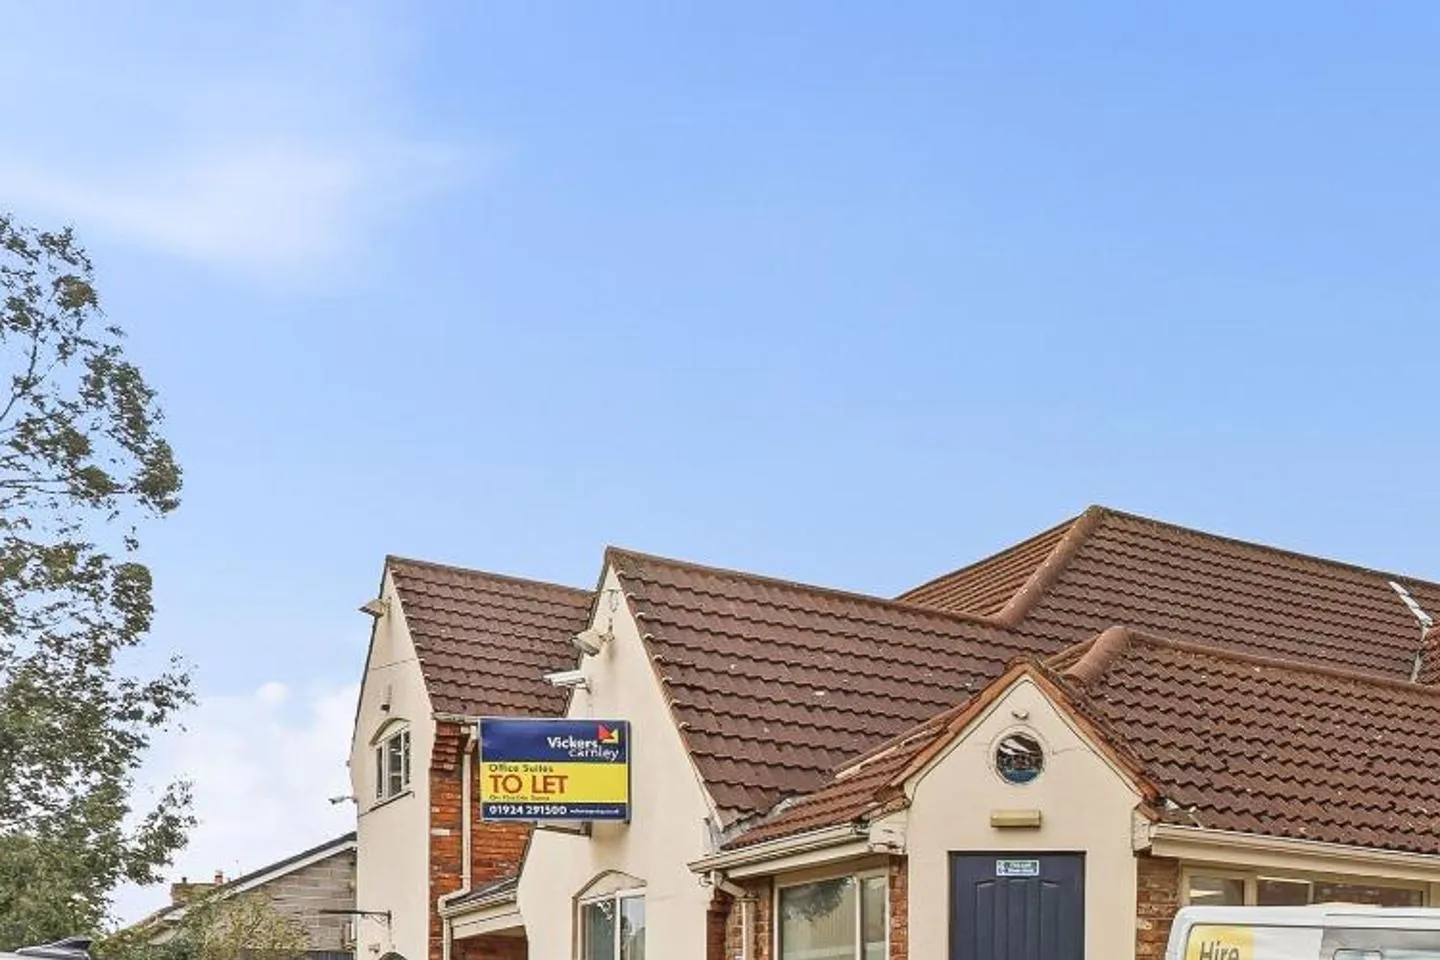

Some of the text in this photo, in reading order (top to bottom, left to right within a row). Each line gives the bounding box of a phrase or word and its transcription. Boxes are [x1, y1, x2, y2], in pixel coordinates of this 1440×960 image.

[547, 735, 598, 749] Vickers
[489, 764, 554, 773] Office Suites
[489, 774, 569, 793] TO LET
[489, 805, 523, 815] 01924
[525, 805, 567, 815] 291500
